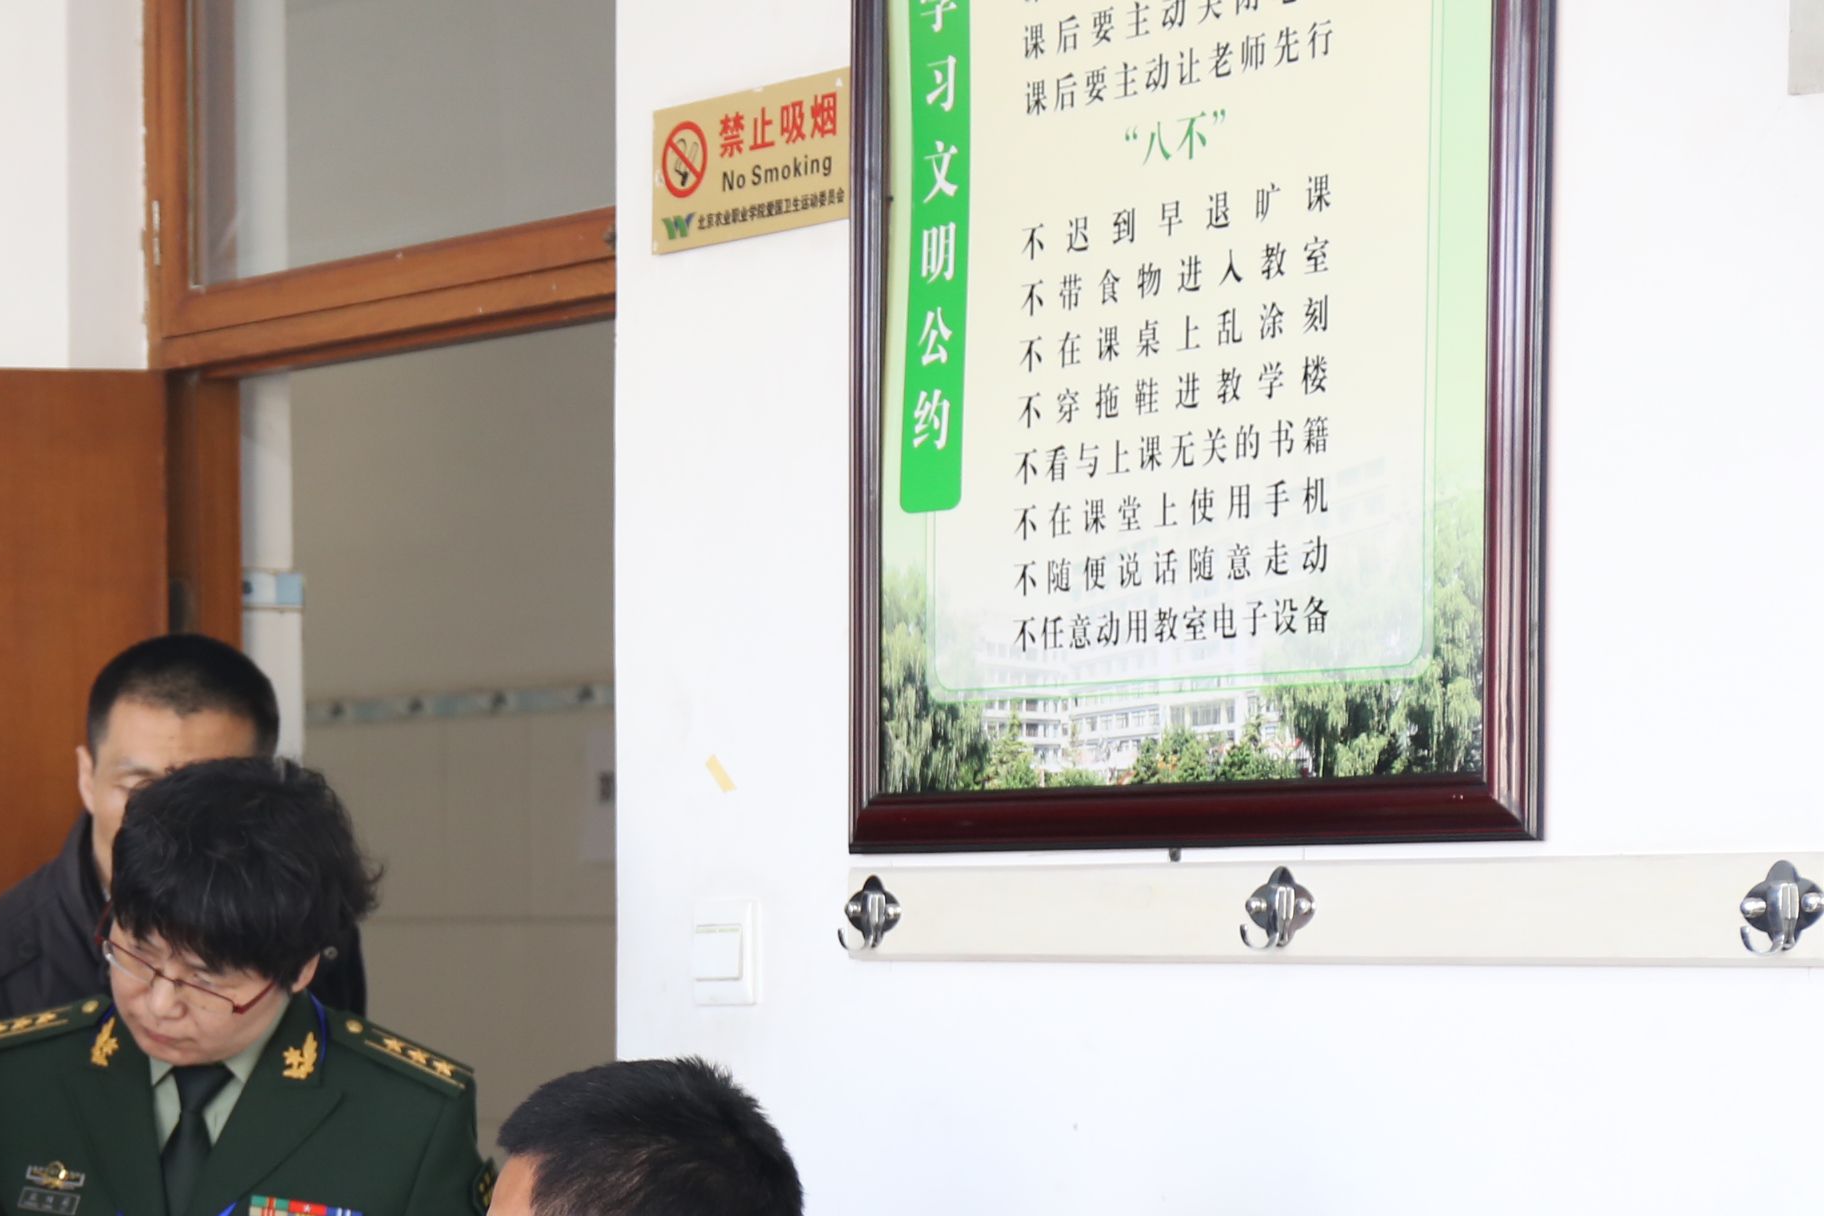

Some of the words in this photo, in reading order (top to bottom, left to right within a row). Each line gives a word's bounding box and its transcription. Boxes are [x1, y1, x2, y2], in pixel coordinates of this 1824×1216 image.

[1024, 19, 1334, 116] 课后要主动让老师先行
[719, 91, 838, 159] 禁止吸烟
[1124, 108, 1227, 166] “八不”
[722, 170, 746, 192] No
[751, 155, 833, 186] Smoking
[1020, 173, 1331, 262] 不迟到早退旷课
[1020, 236, 1330, 318] 不带食物进入教室
[1019, 295, 1329, 373] 不在课桌上乱涂刻
[1018, 355, 1328, 430] 不穿拖鞋进教学楼
[1013, 416, 1329, 486] 不看与上课无关的书籍
[1013, 476, 1328, 542] 不在课堂上使用手机
[1013, 535, 1328, 597] 不随便说话随意走动
[1012, 595, 1329, 654] 不任意动用教室电子设备
